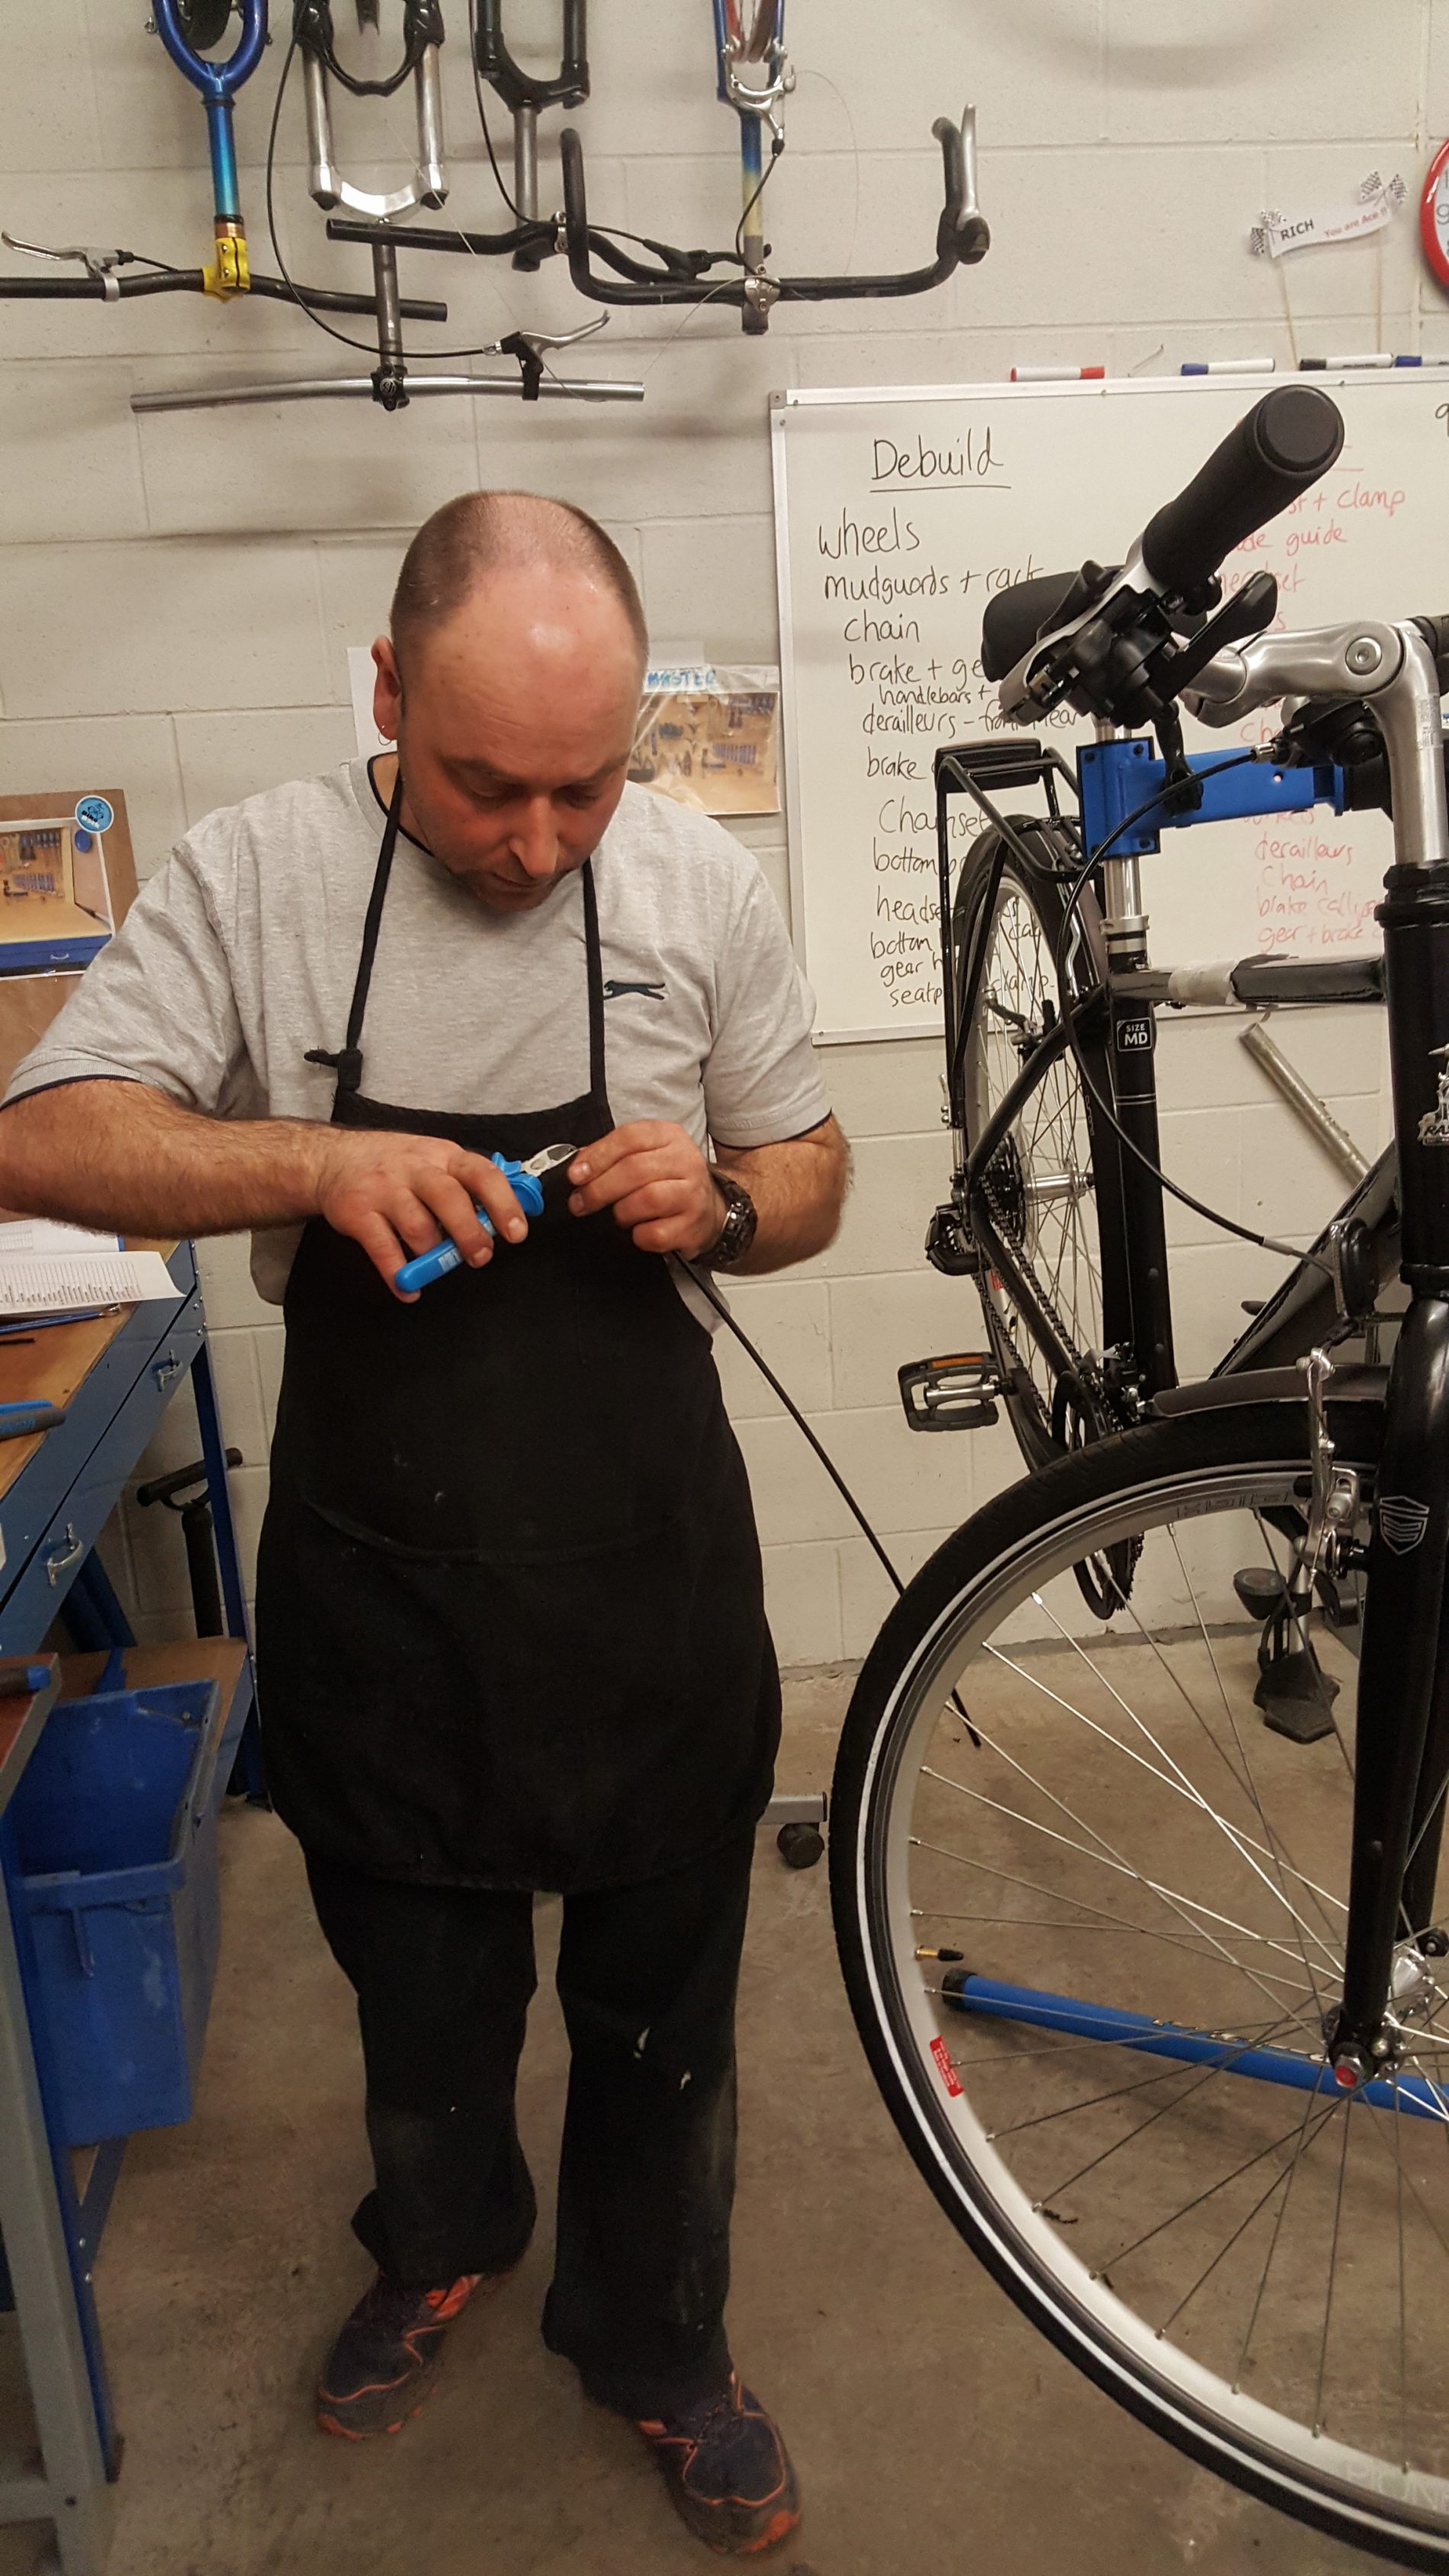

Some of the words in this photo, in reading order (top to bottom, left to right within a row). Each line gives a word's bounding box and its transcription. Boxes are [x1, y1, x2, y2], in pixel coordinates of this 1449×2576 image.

[1280, 218, 1315, 240] RICH
[871, 427, 1004, 481] Debuild
[1337, 483, 1406, 516] clamp
[819, 507, 920, 558] wheels
[1287, 519, 1348, 556] guide
[824, 565, 949, 603] mudguards
[850, 654, 921, 684] brake
[879, 684, 972, 706] handlebars
[863, 703, 956, 738] derailleurs
[866, 746, 928, 780] brake
[873, 837, 939, 875] bottom
[870, 931, 933, 959] bottom
[880, 960, 924, 987] gear
[889, 982, 944, 1007] seatp
[1124, 1032, 1148, 1047] MD
[1126, 1023, 1145, 1033] SIZE
